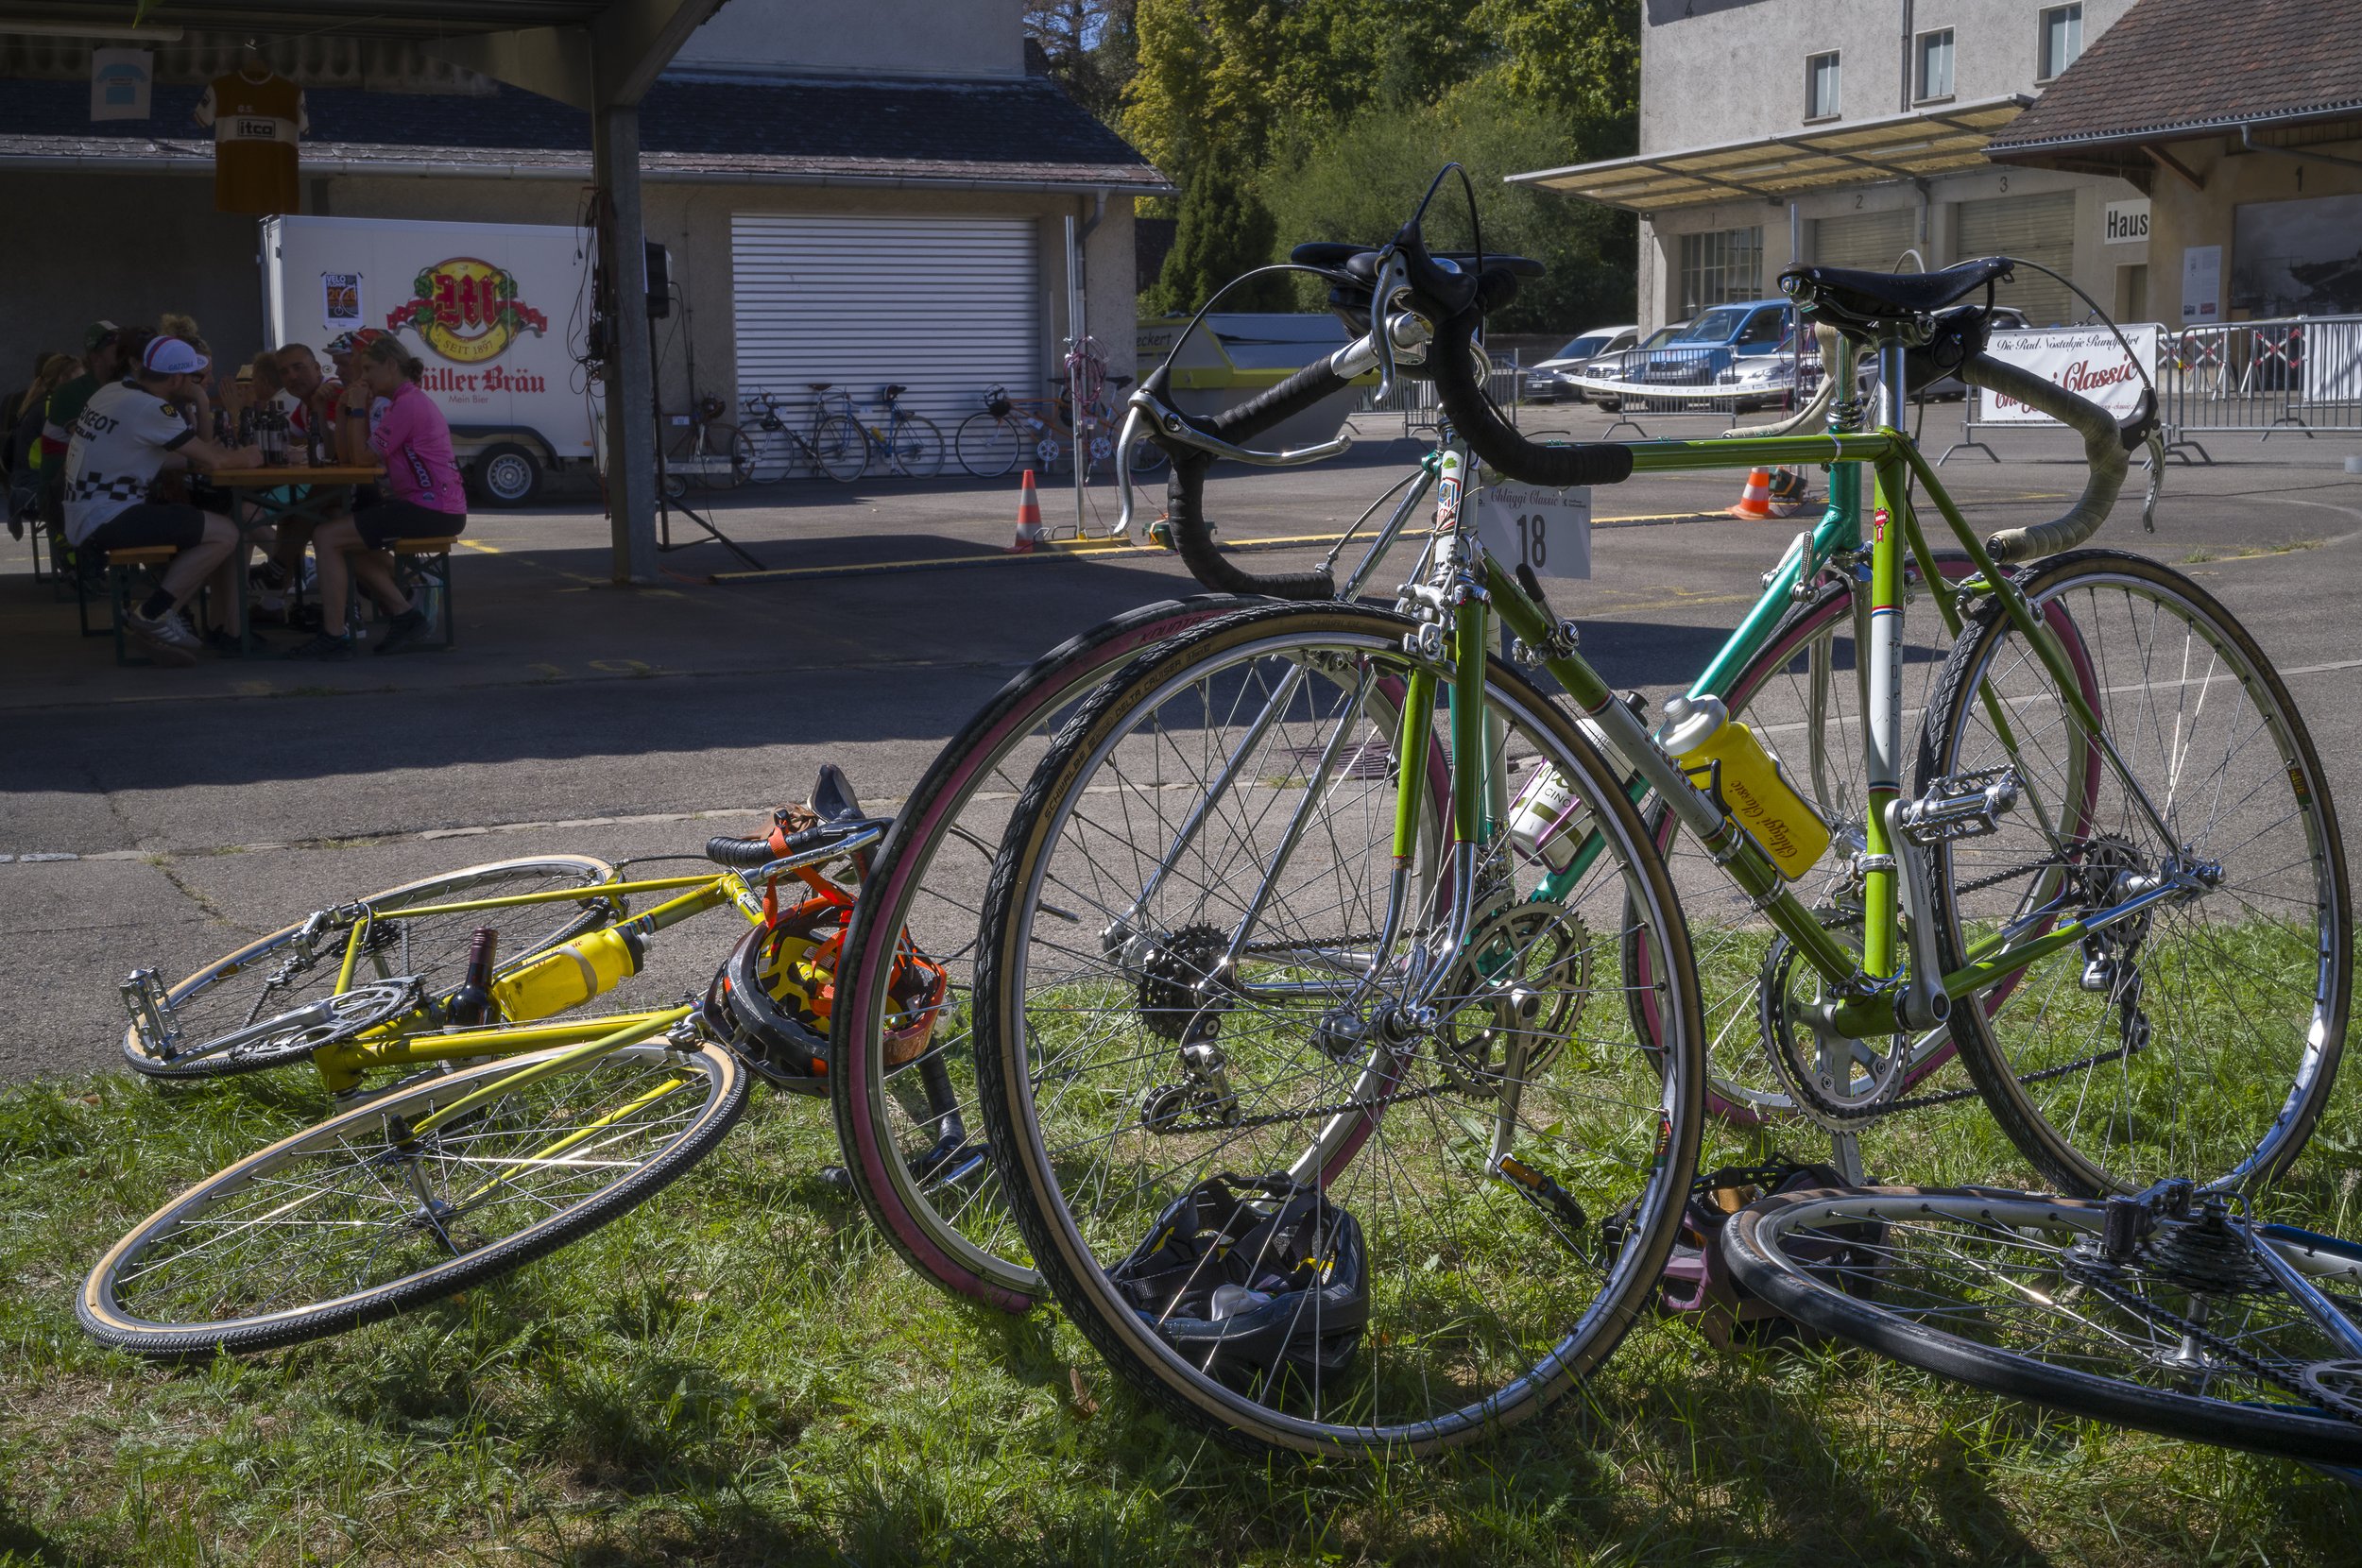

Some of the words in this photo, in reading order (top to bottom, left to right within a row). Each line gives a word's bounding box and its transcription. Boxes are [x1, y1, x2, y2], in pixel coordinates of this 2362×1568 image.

[240, 122, 273, 135] itca
[1999, 176, 2009, 193] 3
[2296, 165, 2303, 192] 1
[1855, 195, 1863, 209] 2
[2107, 210, 2148, 239] Haus
[326, 275, 347, 283] VELO
[443, 341, 470, 355] SEIT
[472, 341, 493, 354] 1897
[1137, 332, 1172, 348] eckert
[1997, 339, 2013, 350] Die
[2086, 333, 2139, 350] Rundfhrt
[423, 366, 479, 393] üller
[483, 365, 546, 393] Bräu
[2062, 353, 2138, 393] Classic
[448, 396, 471, 404] Mein
[472, 396, 488, 404] Bier
[1490, 487, 1528, 509] Chläggi
[1529, 489, 1559, 507] Classic
[1516, 514, 1547, 568] 18
[1115, 689, 1141, 718] DELTA
[1144, 660, 1182, 690] CRUISER
[1044, 750, 1087, 819] SCHWALBE
[1544, 788, 1572, 808] CINO
[1729, 780, 1764, 818] Classic
